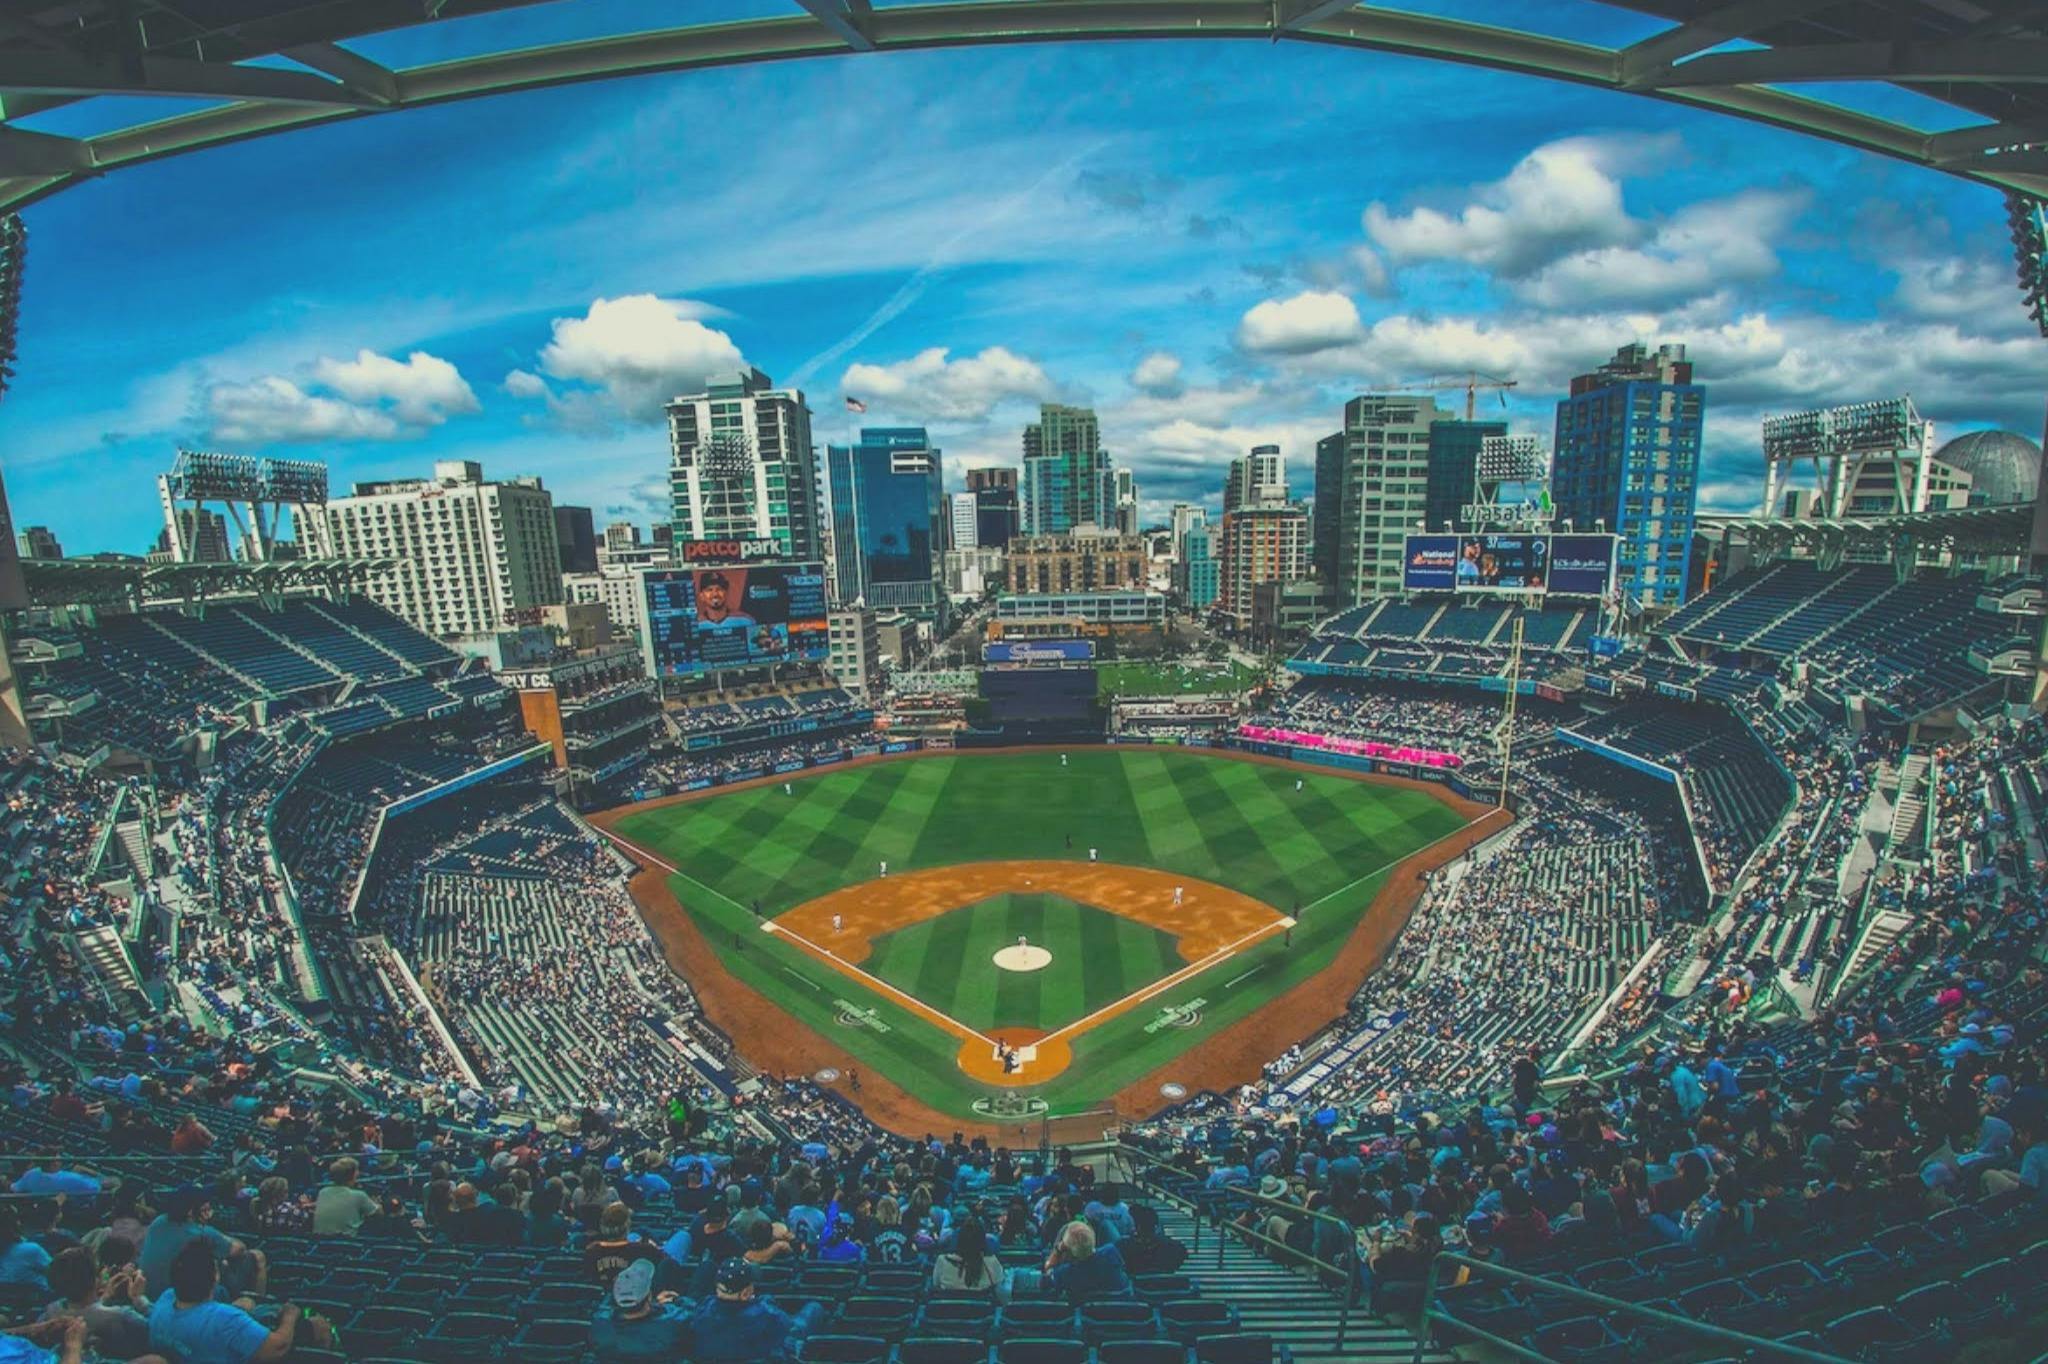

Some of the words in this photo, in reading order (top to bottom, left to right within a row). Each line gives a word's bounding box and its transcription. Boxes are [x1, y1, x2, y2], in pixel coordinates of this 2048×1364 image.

[1462, 504, 1523, 521] Viasat
[685, 541, 740, 561] petco
[740, 539, 781, 559] park
[1422, 550, 1455, 559] National
[531, 673, 555, 688] CO.
